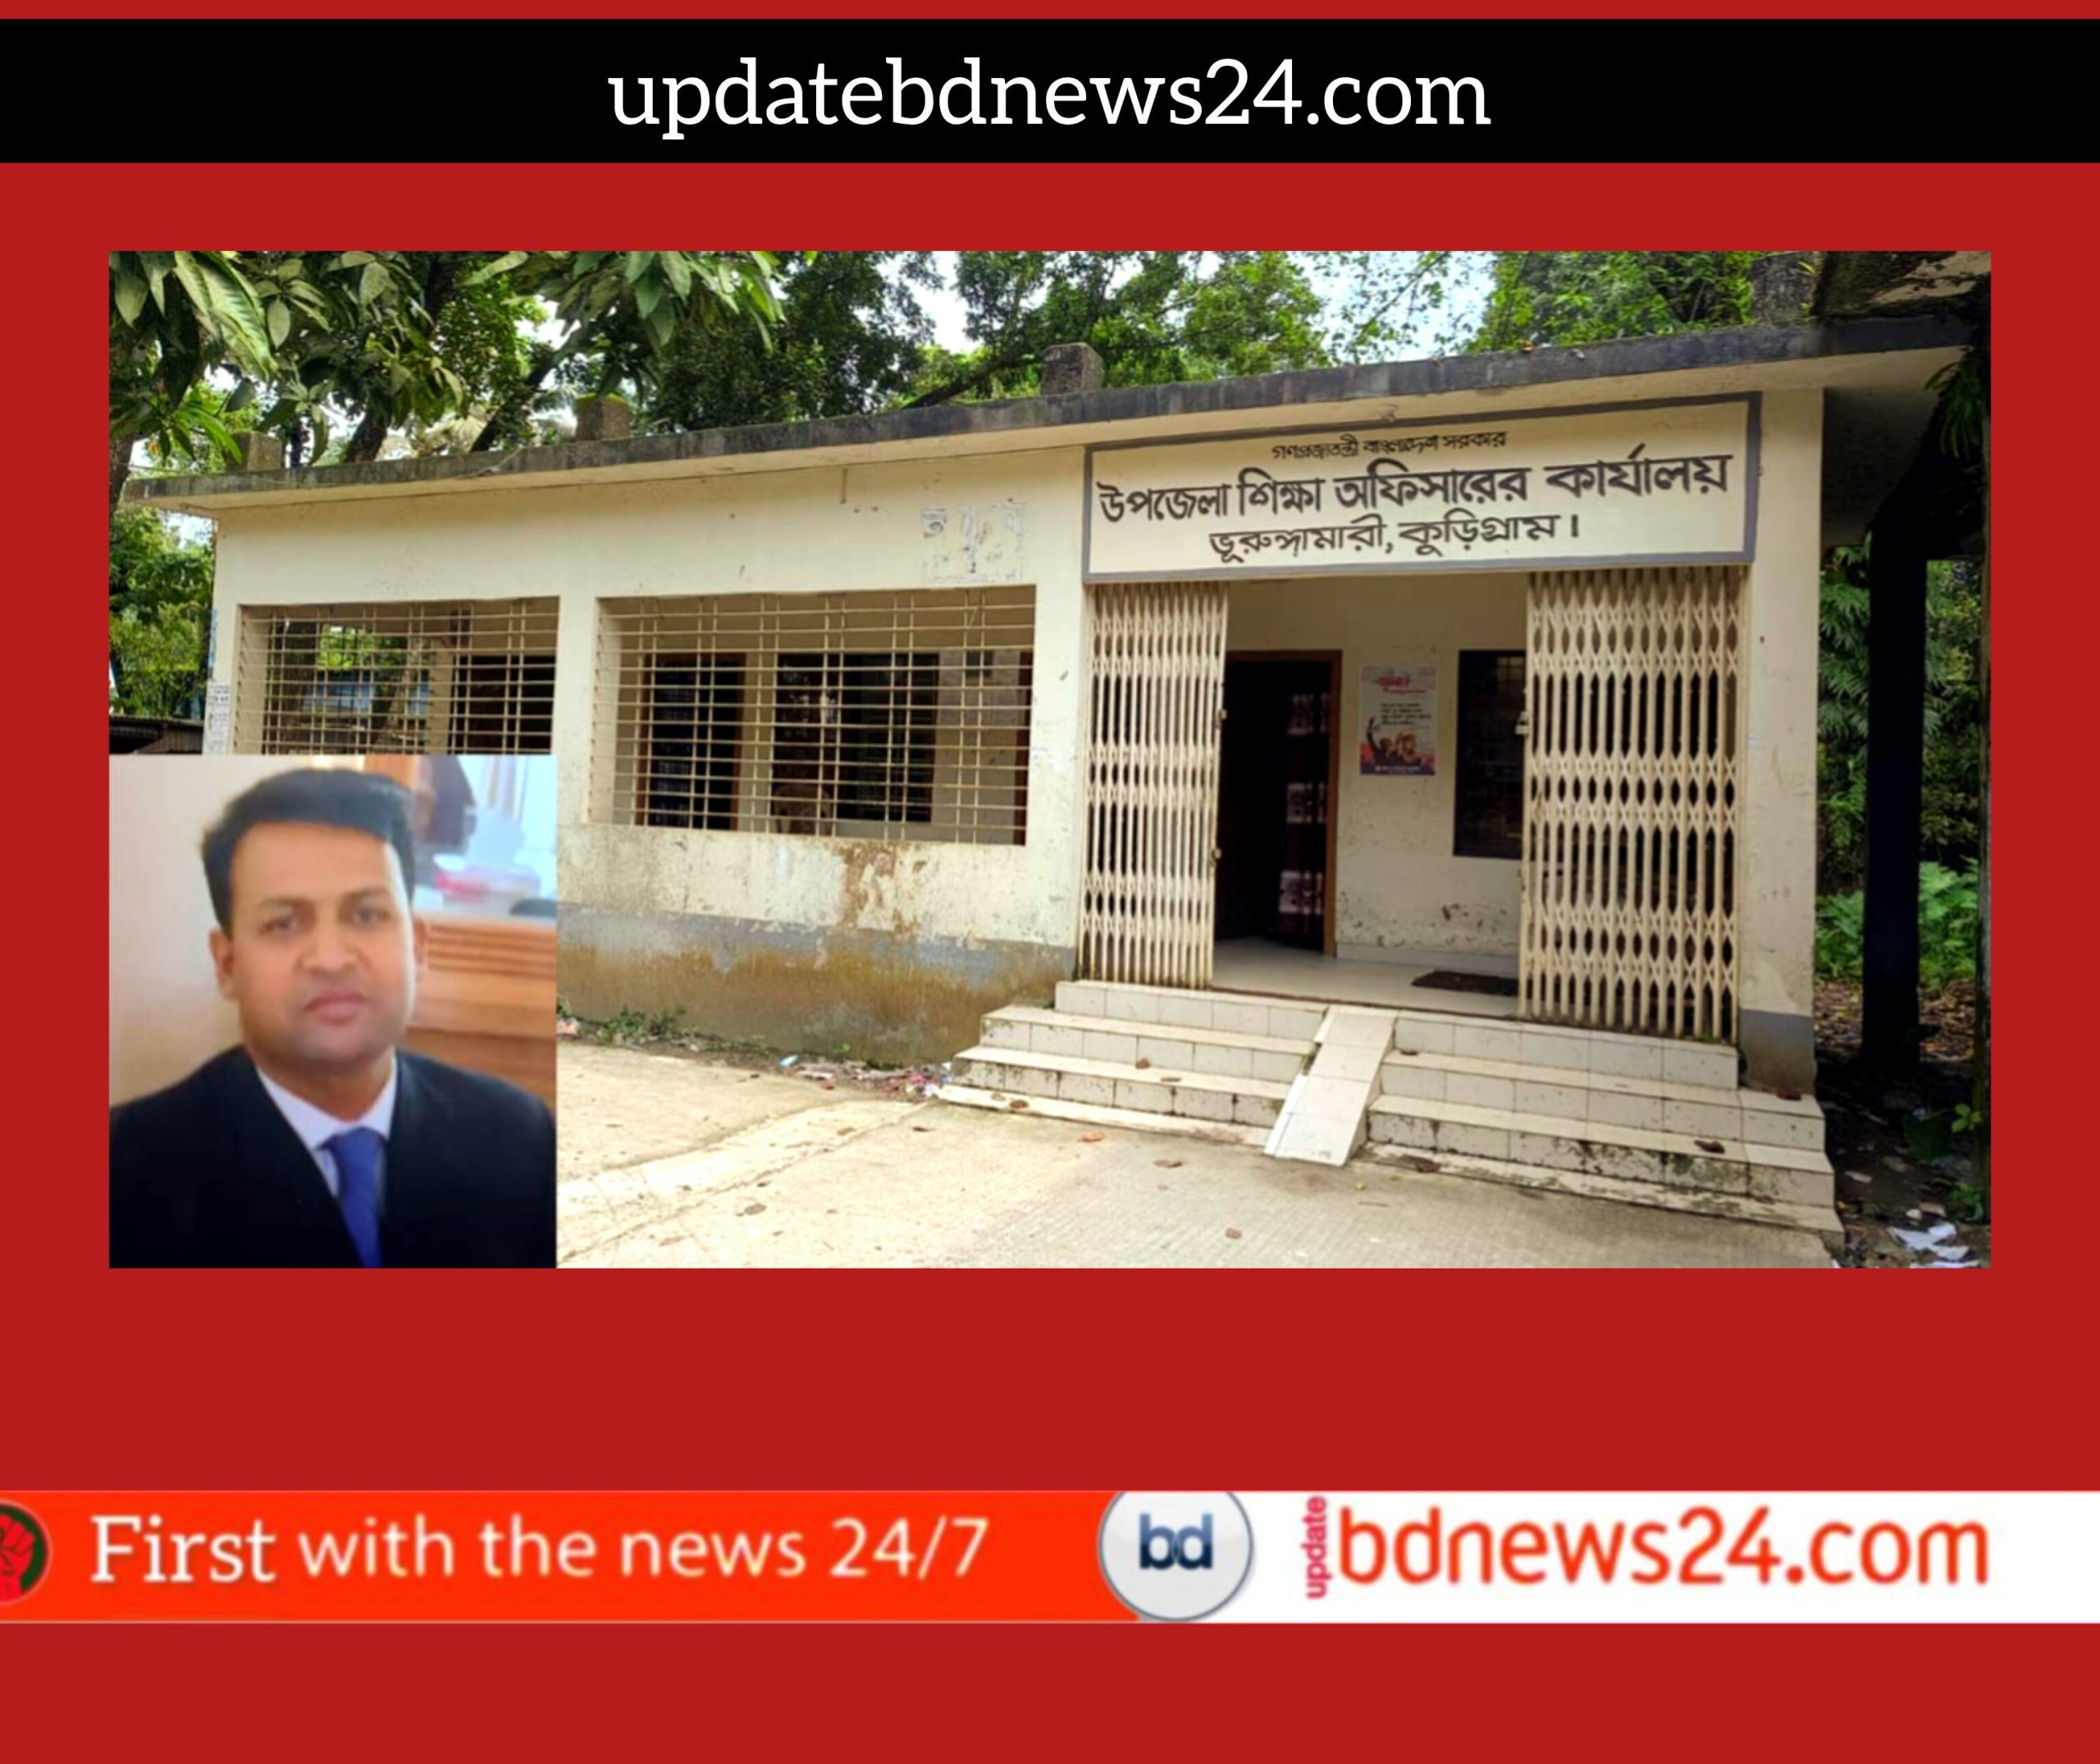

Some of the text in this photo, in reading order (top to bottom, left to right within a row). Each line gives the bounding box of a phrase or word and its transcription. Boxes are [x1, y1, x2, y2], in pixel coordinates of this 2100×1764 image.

[1442, 431, 1507, 448] সরকার
[1096, 443, 1733, 523] উপজেলা শিক্ষা অফিসারের কার্যালয়
